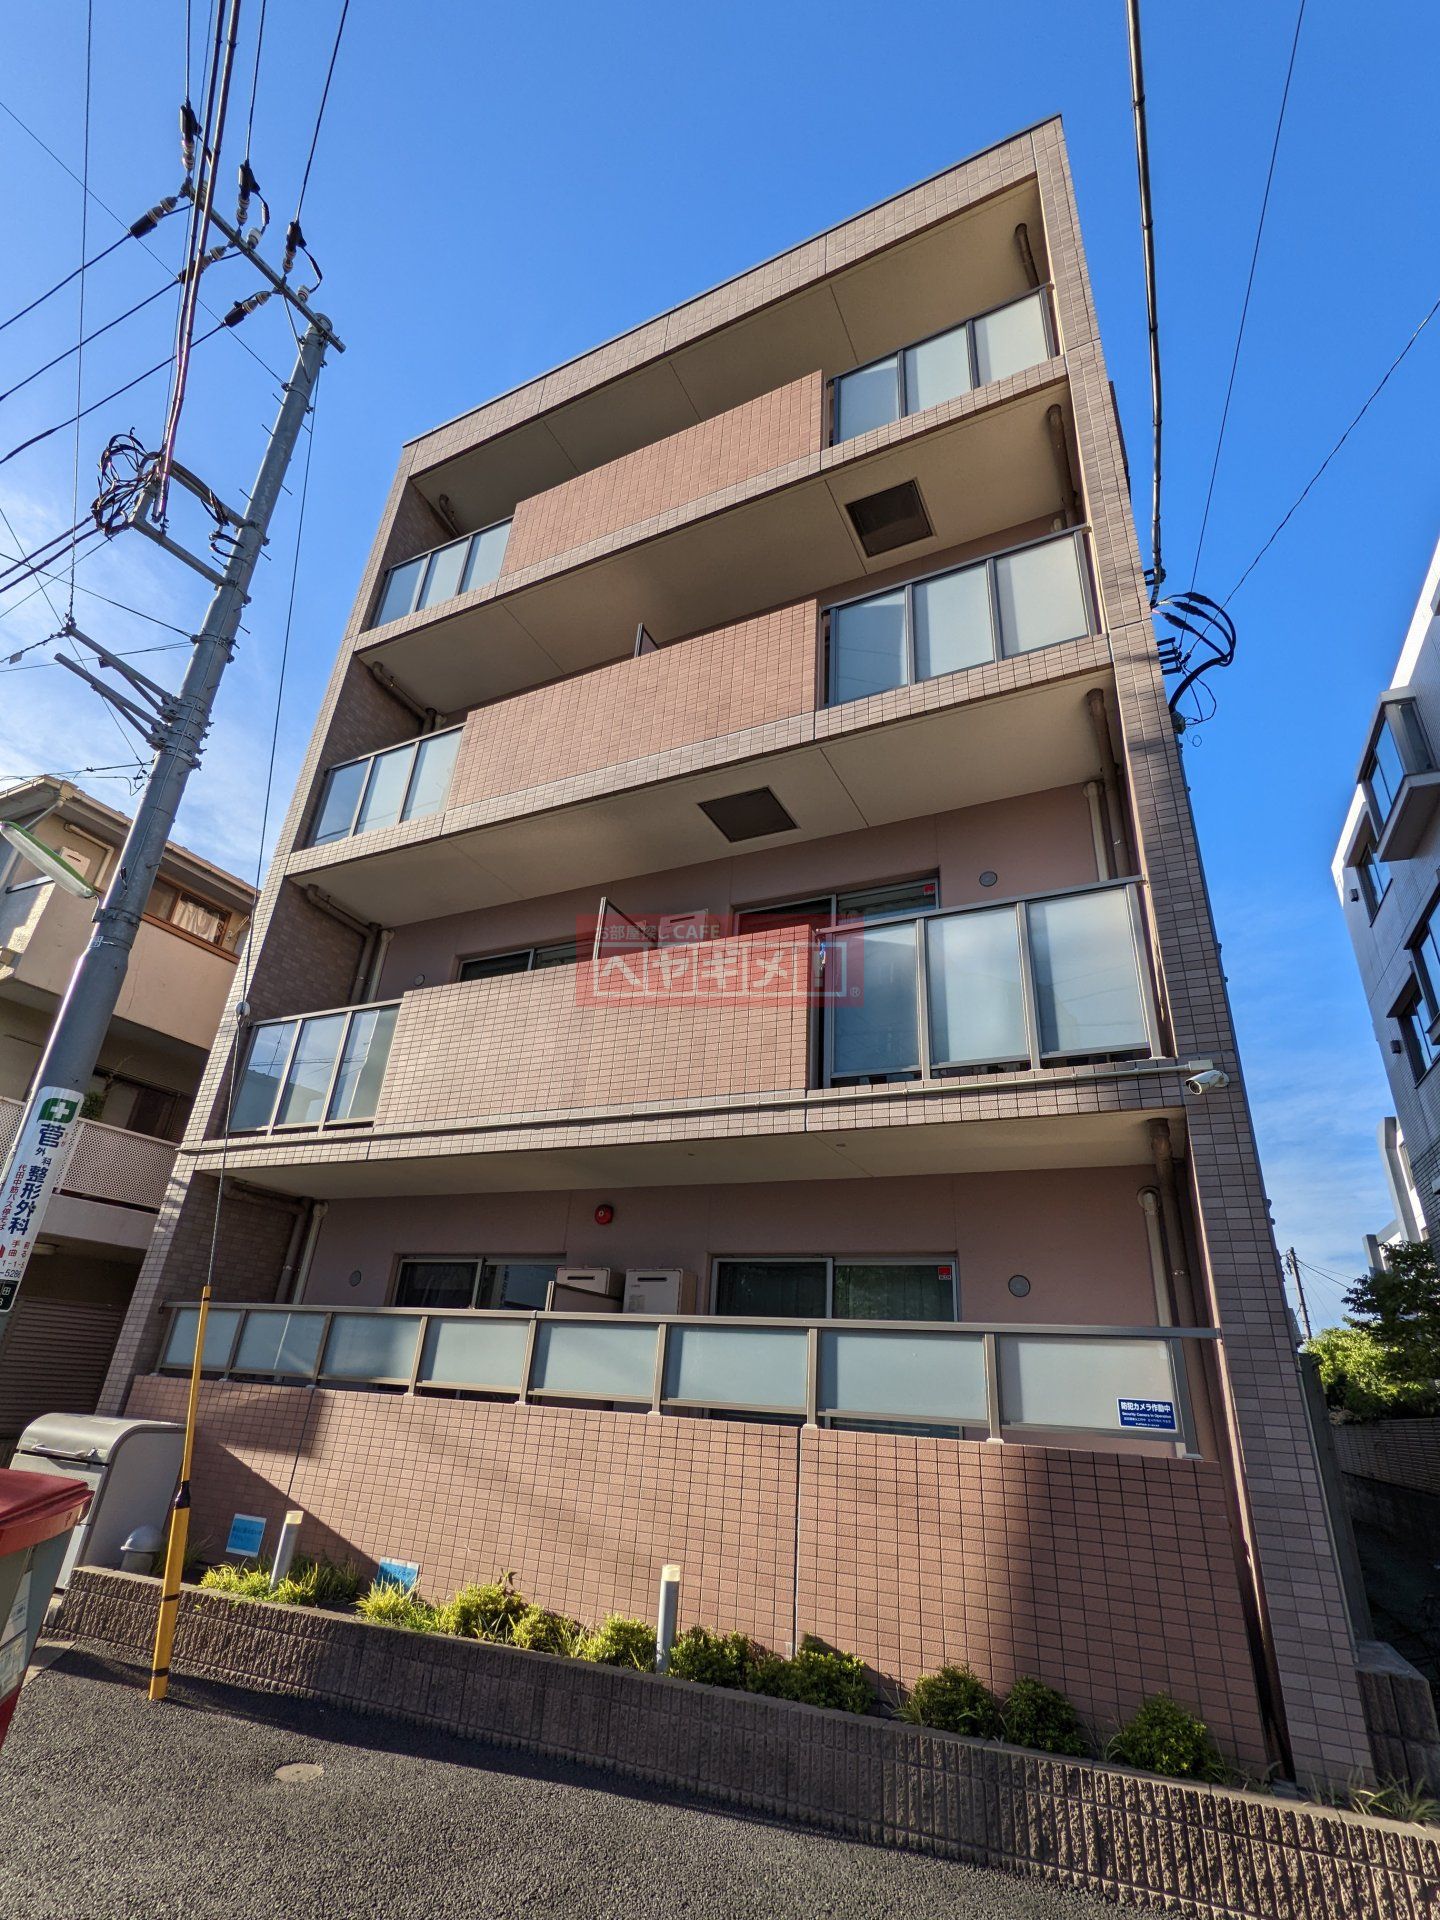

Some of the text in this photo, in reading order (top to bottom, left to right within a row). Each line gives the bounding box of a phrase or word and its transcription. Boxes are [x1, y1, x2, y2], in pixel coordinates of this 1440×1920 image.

[39, 1123, 66, 1148] 菅
[8, 1165, 48, 1235] 整形外科
[1121, 1401, 1171, 1412] 防犯カメラ作動中
